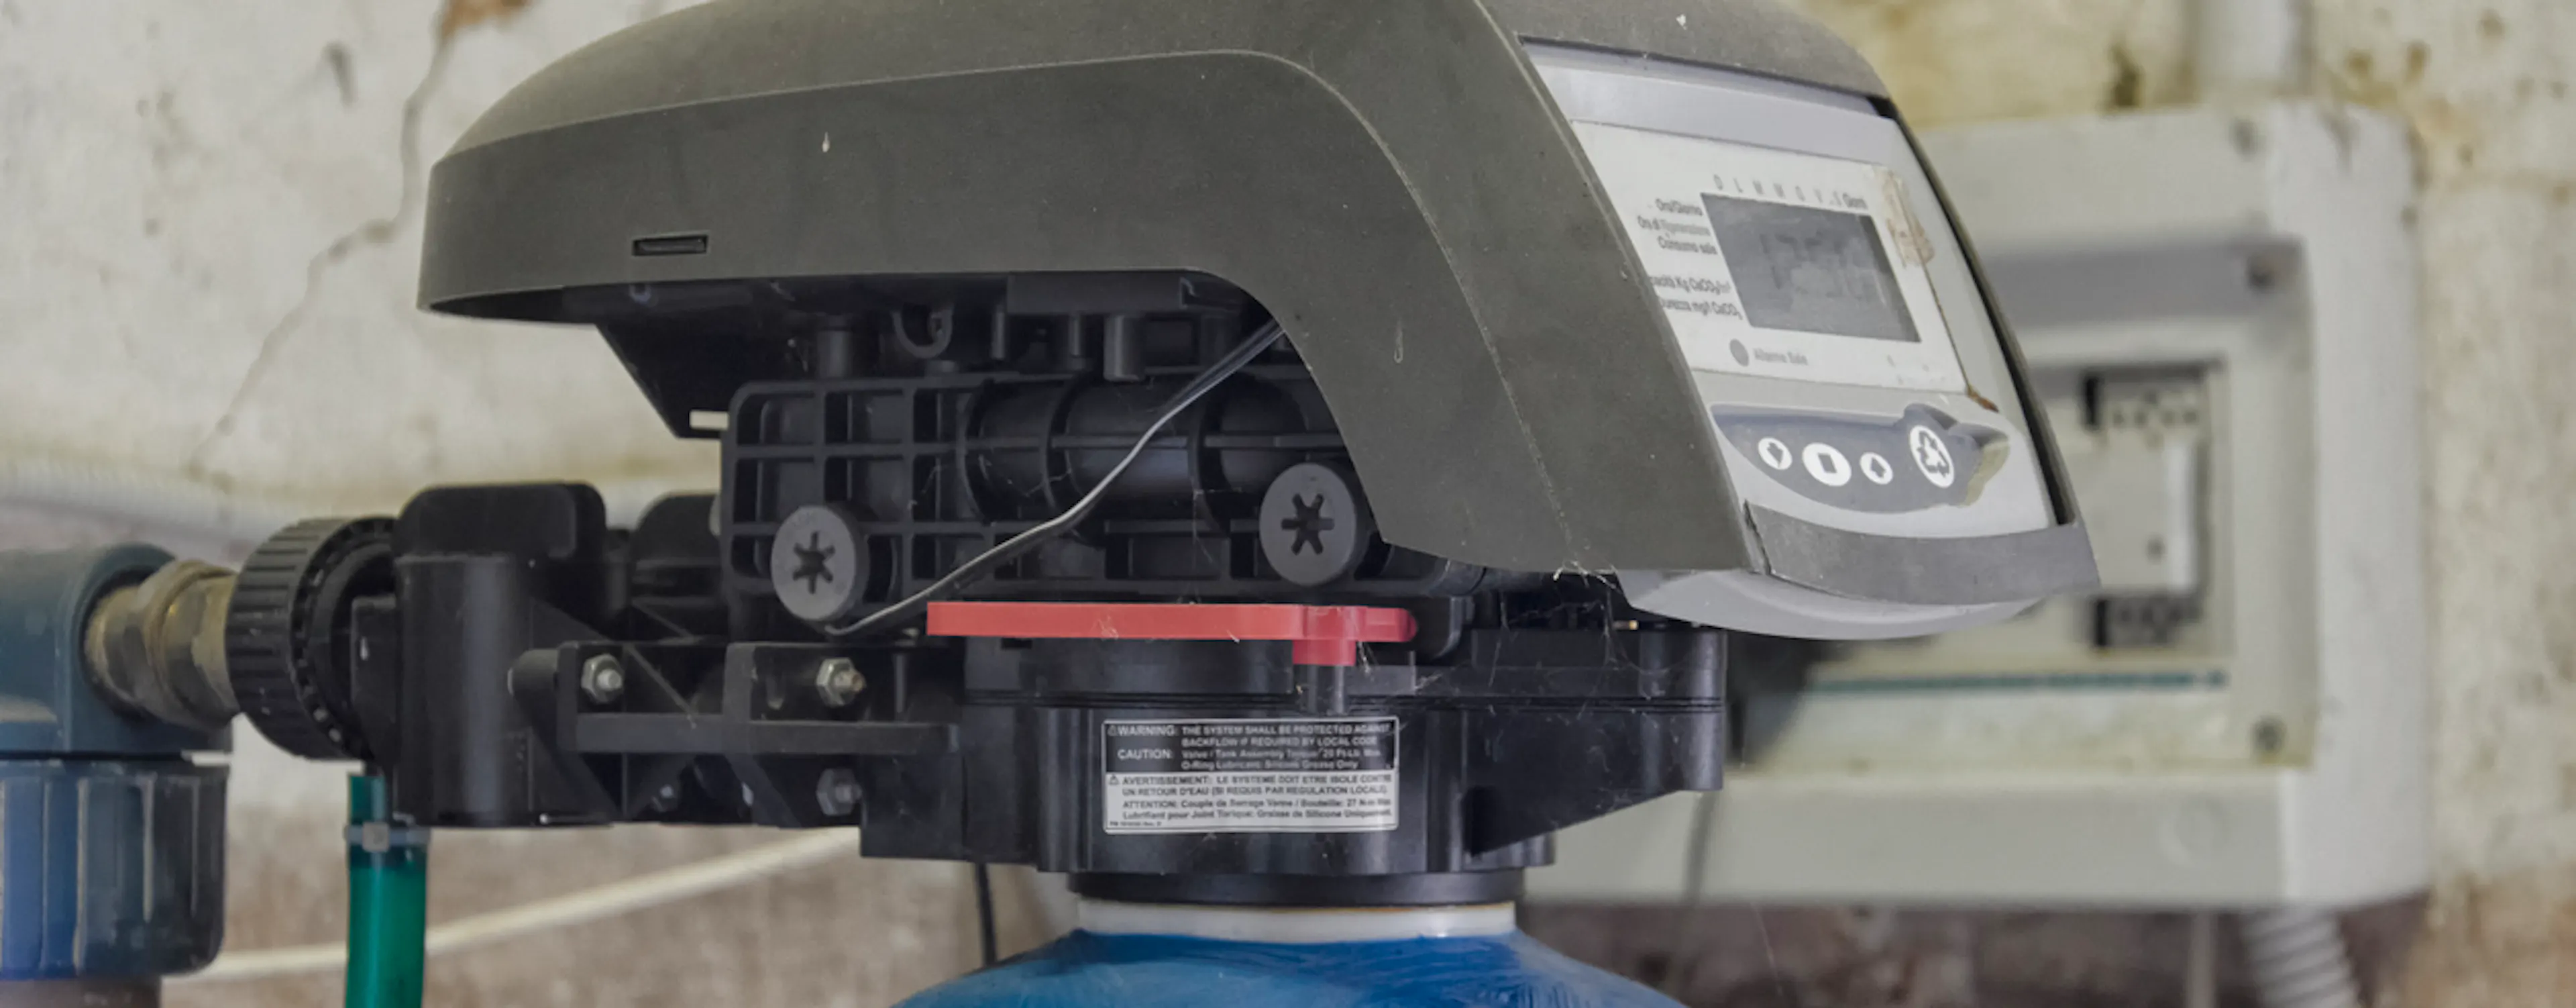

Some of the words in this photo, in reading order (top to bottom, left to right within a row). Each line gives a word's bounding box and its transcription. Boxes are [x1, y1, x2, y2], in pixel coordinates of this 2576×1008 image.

[1182, 725, 1201, 735] THE
[1203, 725, 1244, 735] SYSTEM
[1245, 725, 1276, 734] SHALL
[1279, 725, 1291, 734] BE
[1293, 725, 1352, 734] PROTECTED
